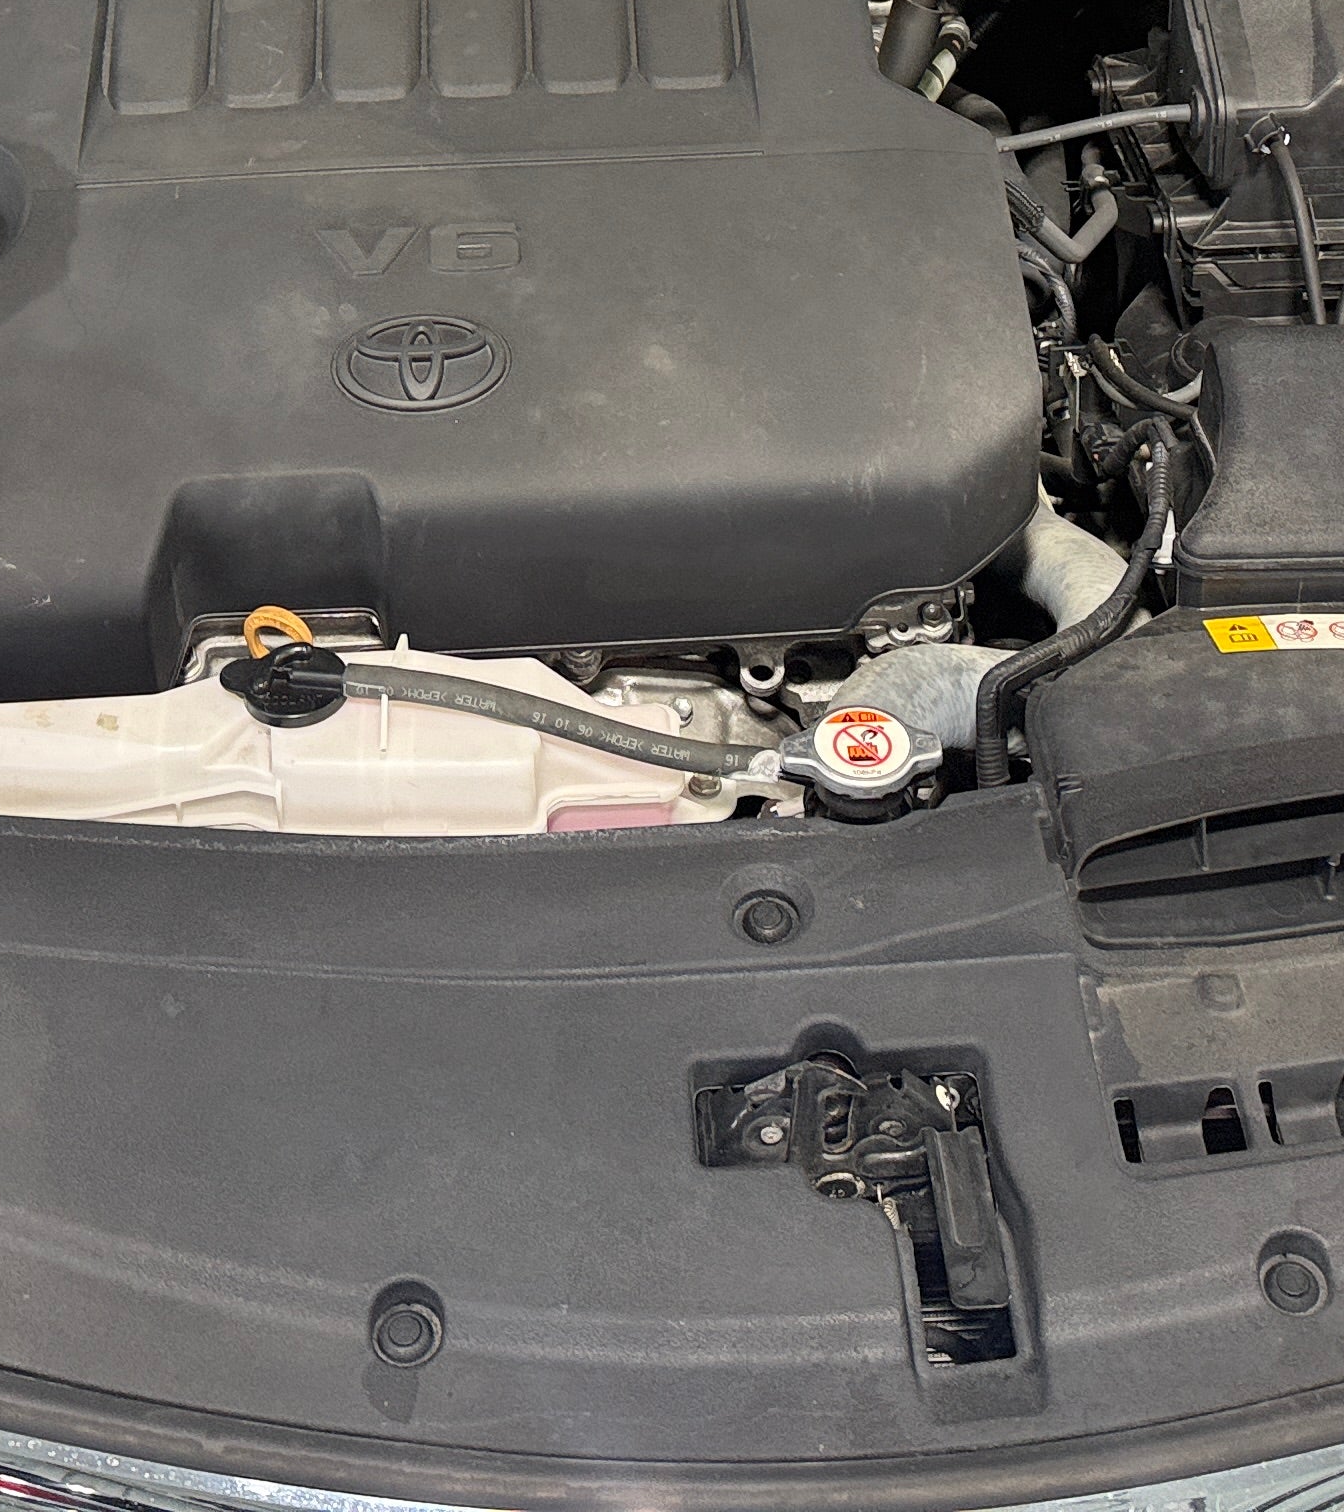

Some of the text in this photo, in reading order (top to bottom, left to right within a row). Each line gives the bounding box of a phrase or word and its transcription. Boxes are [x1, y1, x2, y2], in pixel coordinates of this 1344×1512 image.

[314, 222, 522, 277] V6
[454, 694, 497, 713] WATER
[531, 711, 547, 725] 16
[555, 717, 570, 731] 10
[577, 724, 593, 738] 06
[650, 743, 691, 762] WATER
[725, 754, 740, 767] 16
